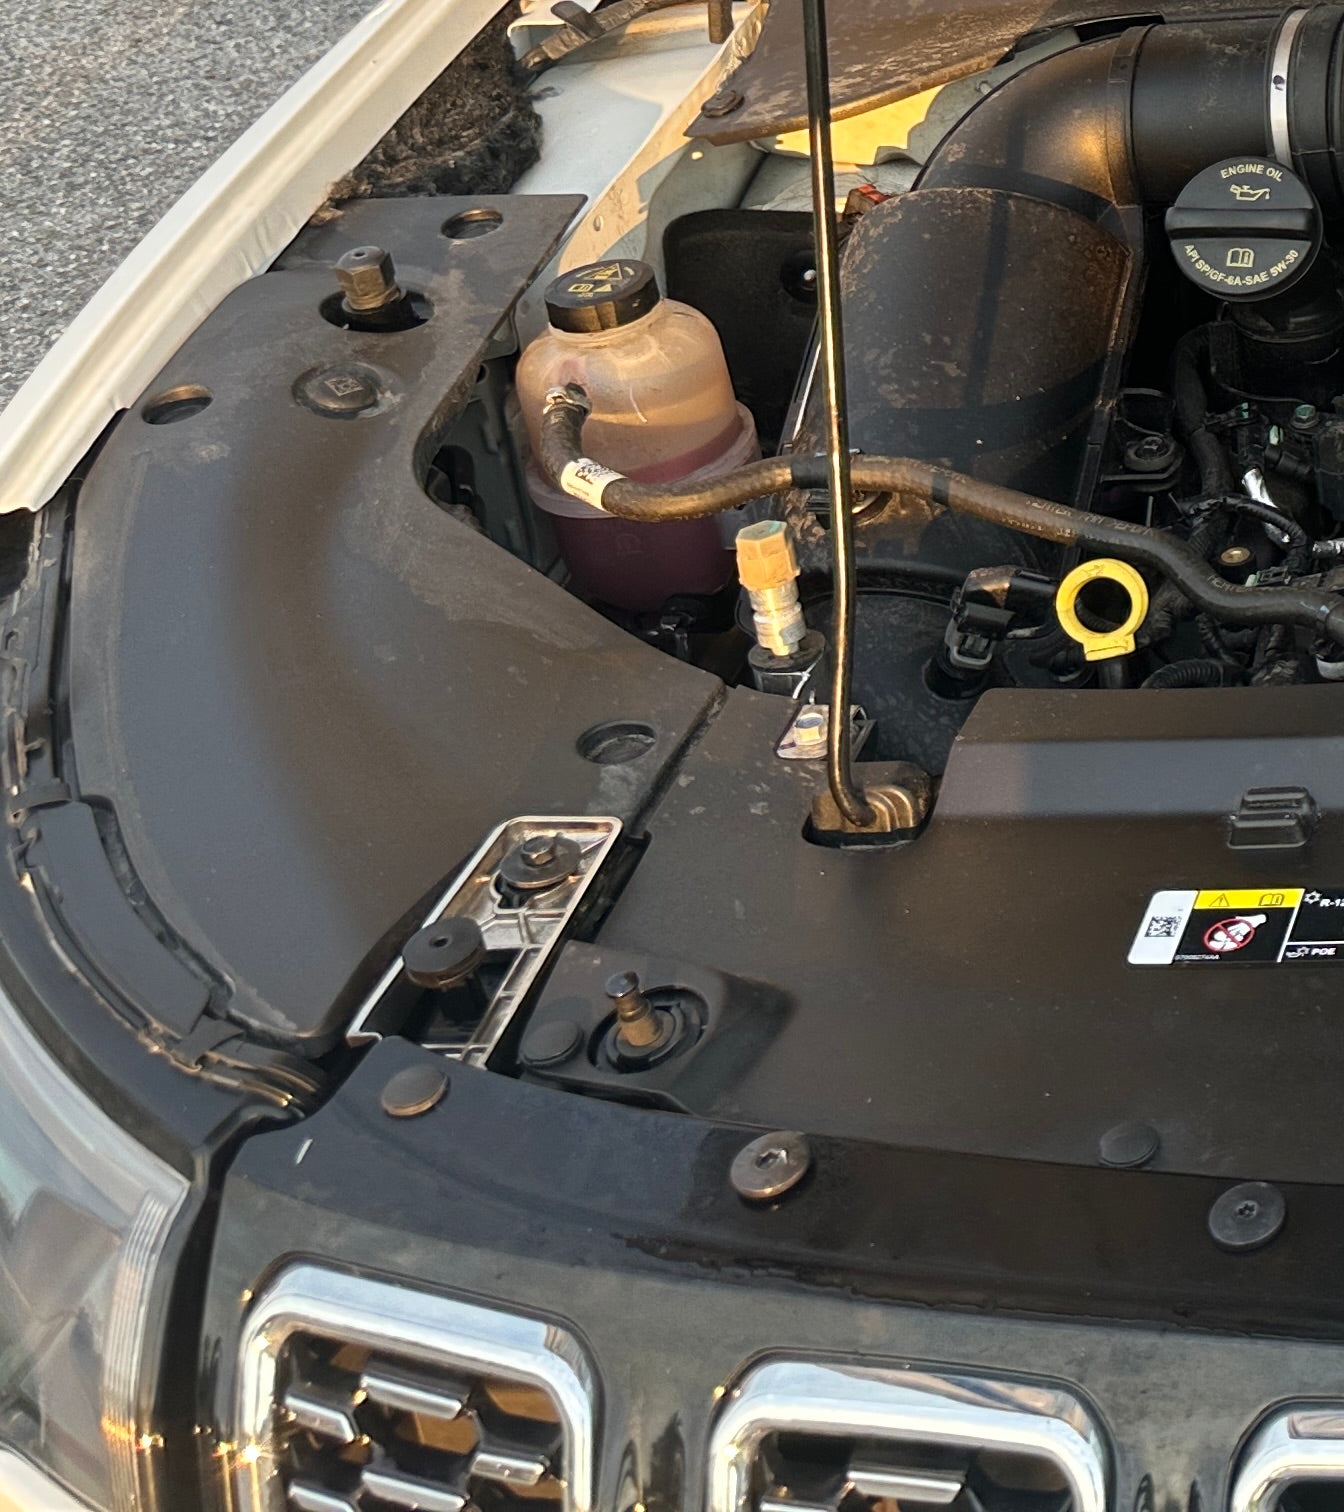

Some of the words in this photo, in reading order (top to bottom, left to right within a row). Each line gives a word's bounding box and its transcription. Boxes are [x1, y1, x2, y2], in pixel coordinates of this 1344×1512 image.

[1220, 164, 1264, 179] ENGINE
[1266, 167, 1284, 182] OIL
[1184, 244, 1200, 262] API
[1269, 249, 1299, 277] 5W-30
[1310, 947, 1336, 956] POE
